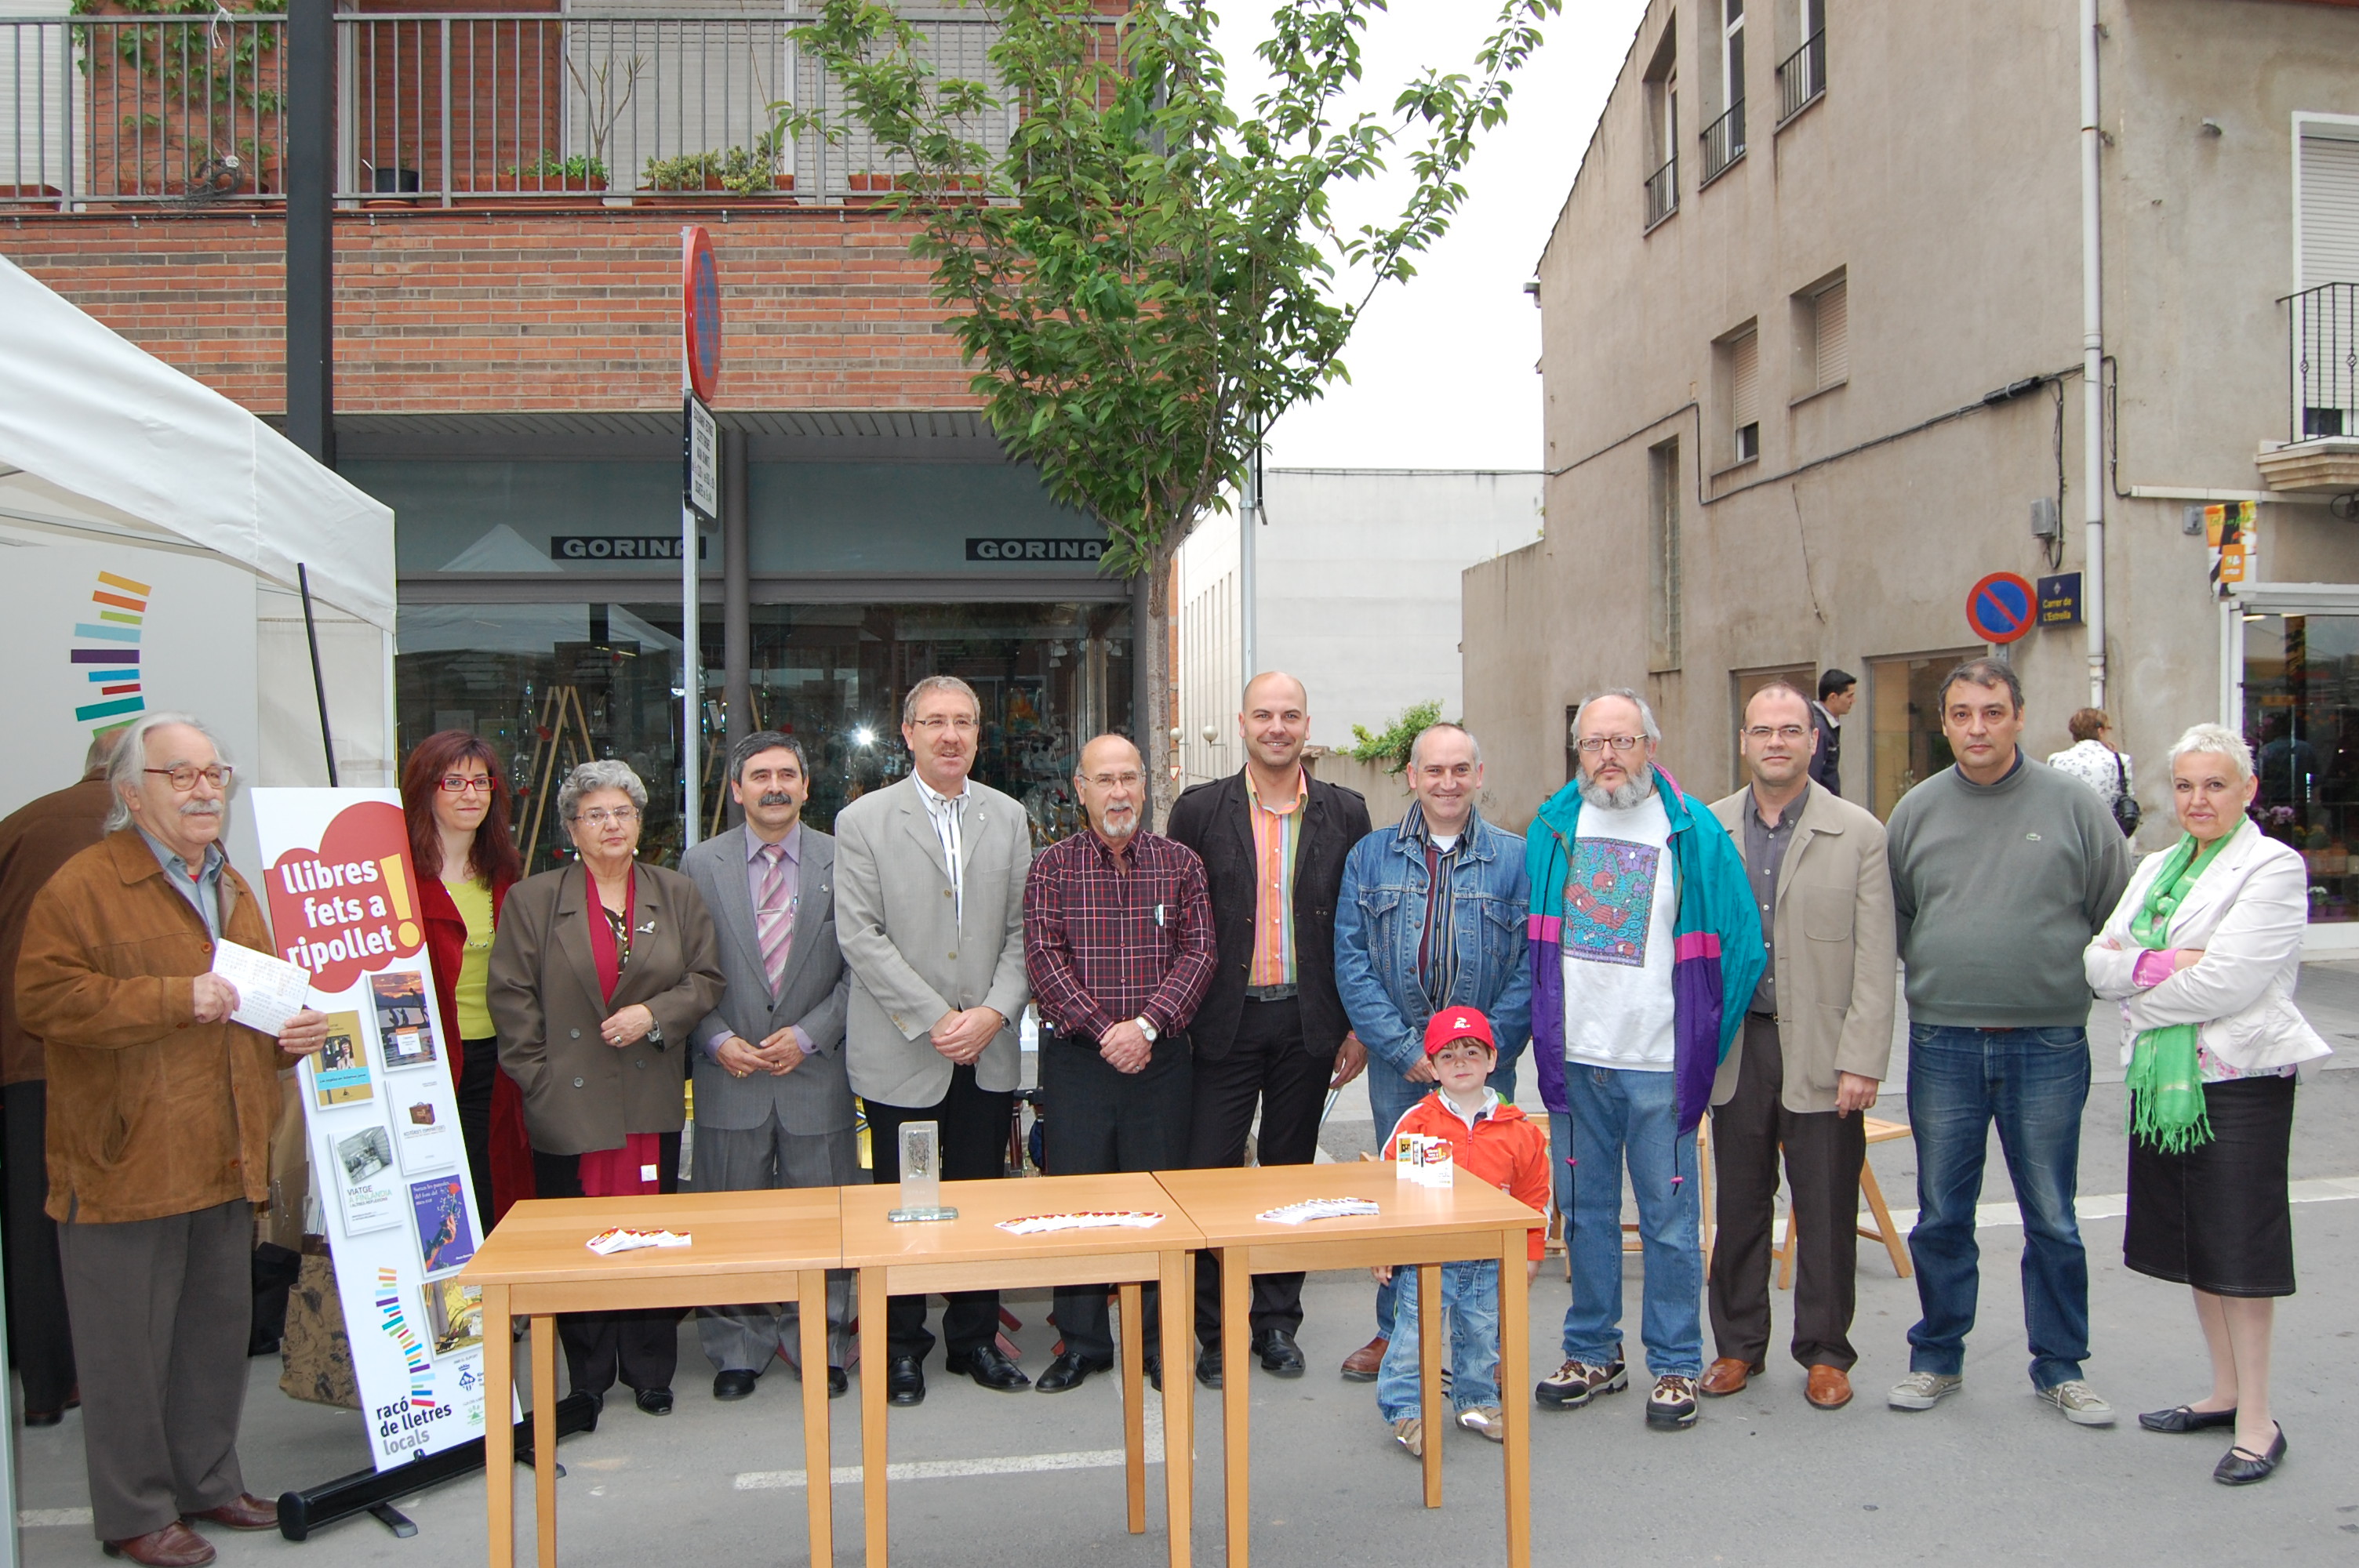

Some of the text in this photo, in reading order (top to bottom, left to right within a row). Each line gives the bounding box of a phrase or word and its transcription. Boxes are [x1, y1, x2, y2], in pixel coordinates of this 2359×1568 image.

[976, 541, 1102, 558] GORINA
[2042, 597, 2072, 609] Carrer de
[281, 859, 379, 895] llibres
[304, 895, 387, 928] fets a
[285, 925, 397, 975] ripollet
[347, 1185, 373, 1196] VIATGE
[376, 1396, 409, 1420] racó
[380, 1421, 399, 1438] de
[402, 1404, 452, 1431] lletres
[383, 1428, 430, 1456] locals
